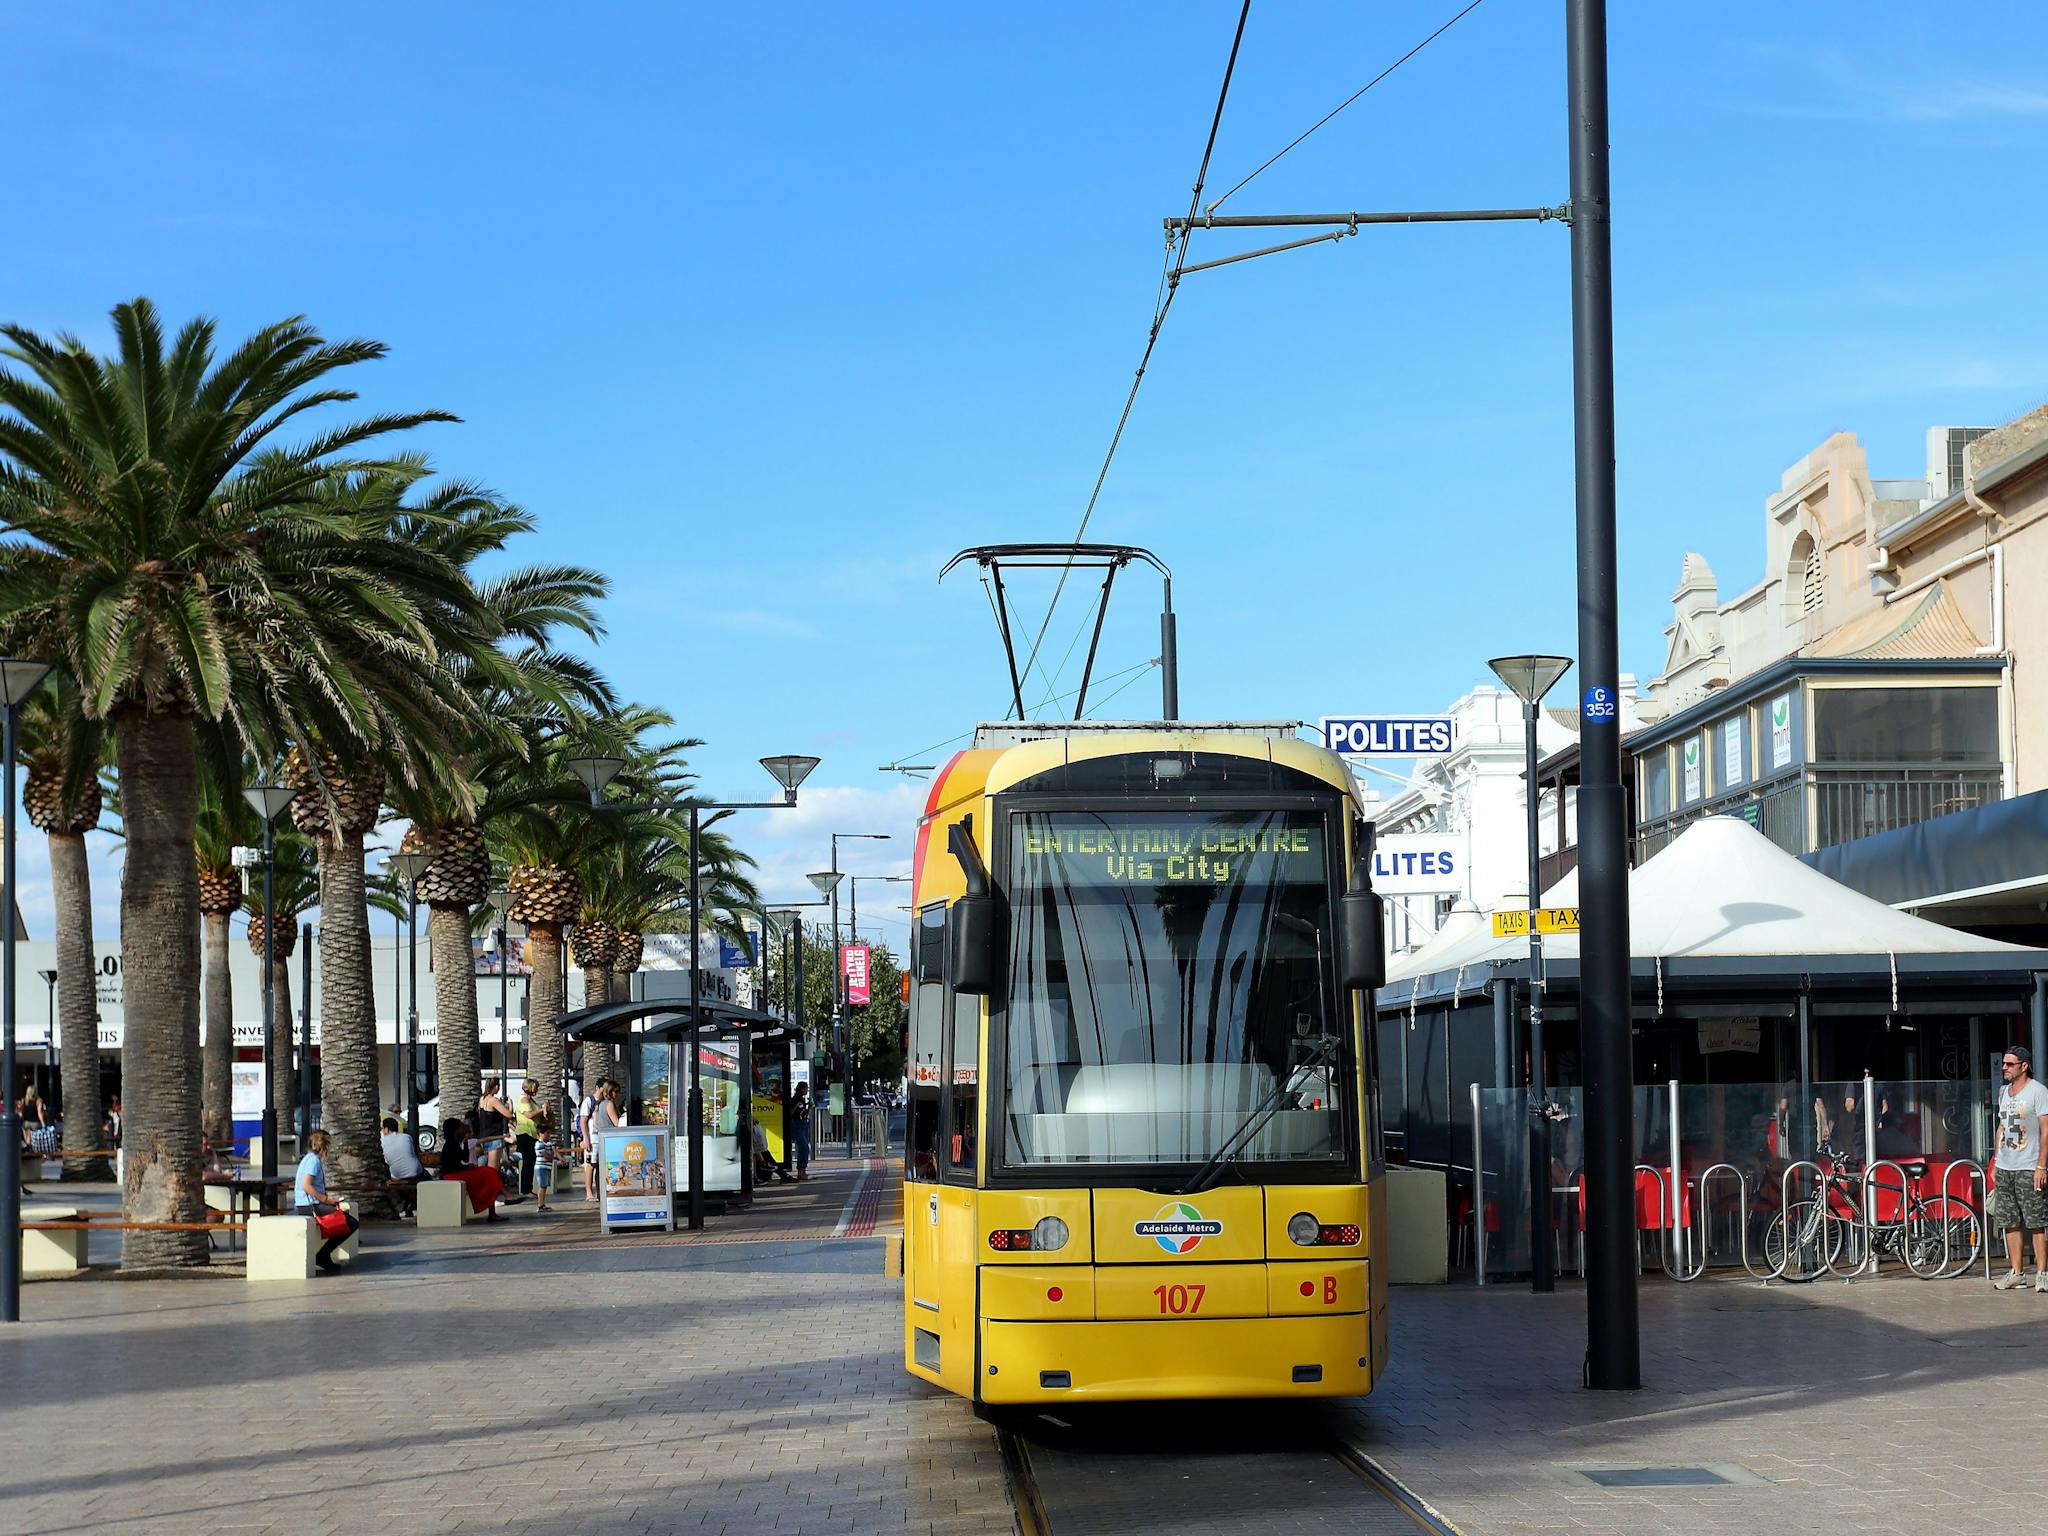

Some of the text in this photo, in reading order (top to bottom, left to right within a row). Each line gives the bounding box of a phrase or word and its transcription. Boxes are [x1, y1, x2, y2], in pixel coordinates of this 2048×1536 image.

[1595, 688, 1606, 702] G
[1586, 703, 1615, 717] 352
[1329, 721, 1450, 752] POLITES
[1107, 855, 1230, 882] Via City
[1498, 912, 1524, 929] TAXIS
[854, 949, 866, 988] GLENELG
[757, 1104, 775, 1112] now
[626, 1145, 643, 1153] PLAY
[628, 1153, 642, 1161] BAY
[1142, 1223, 1215, 1234] Adelaide Metro
[1323, 1276, 1338, 1305] B
[1153, 1284, 1206, 1314] 107
